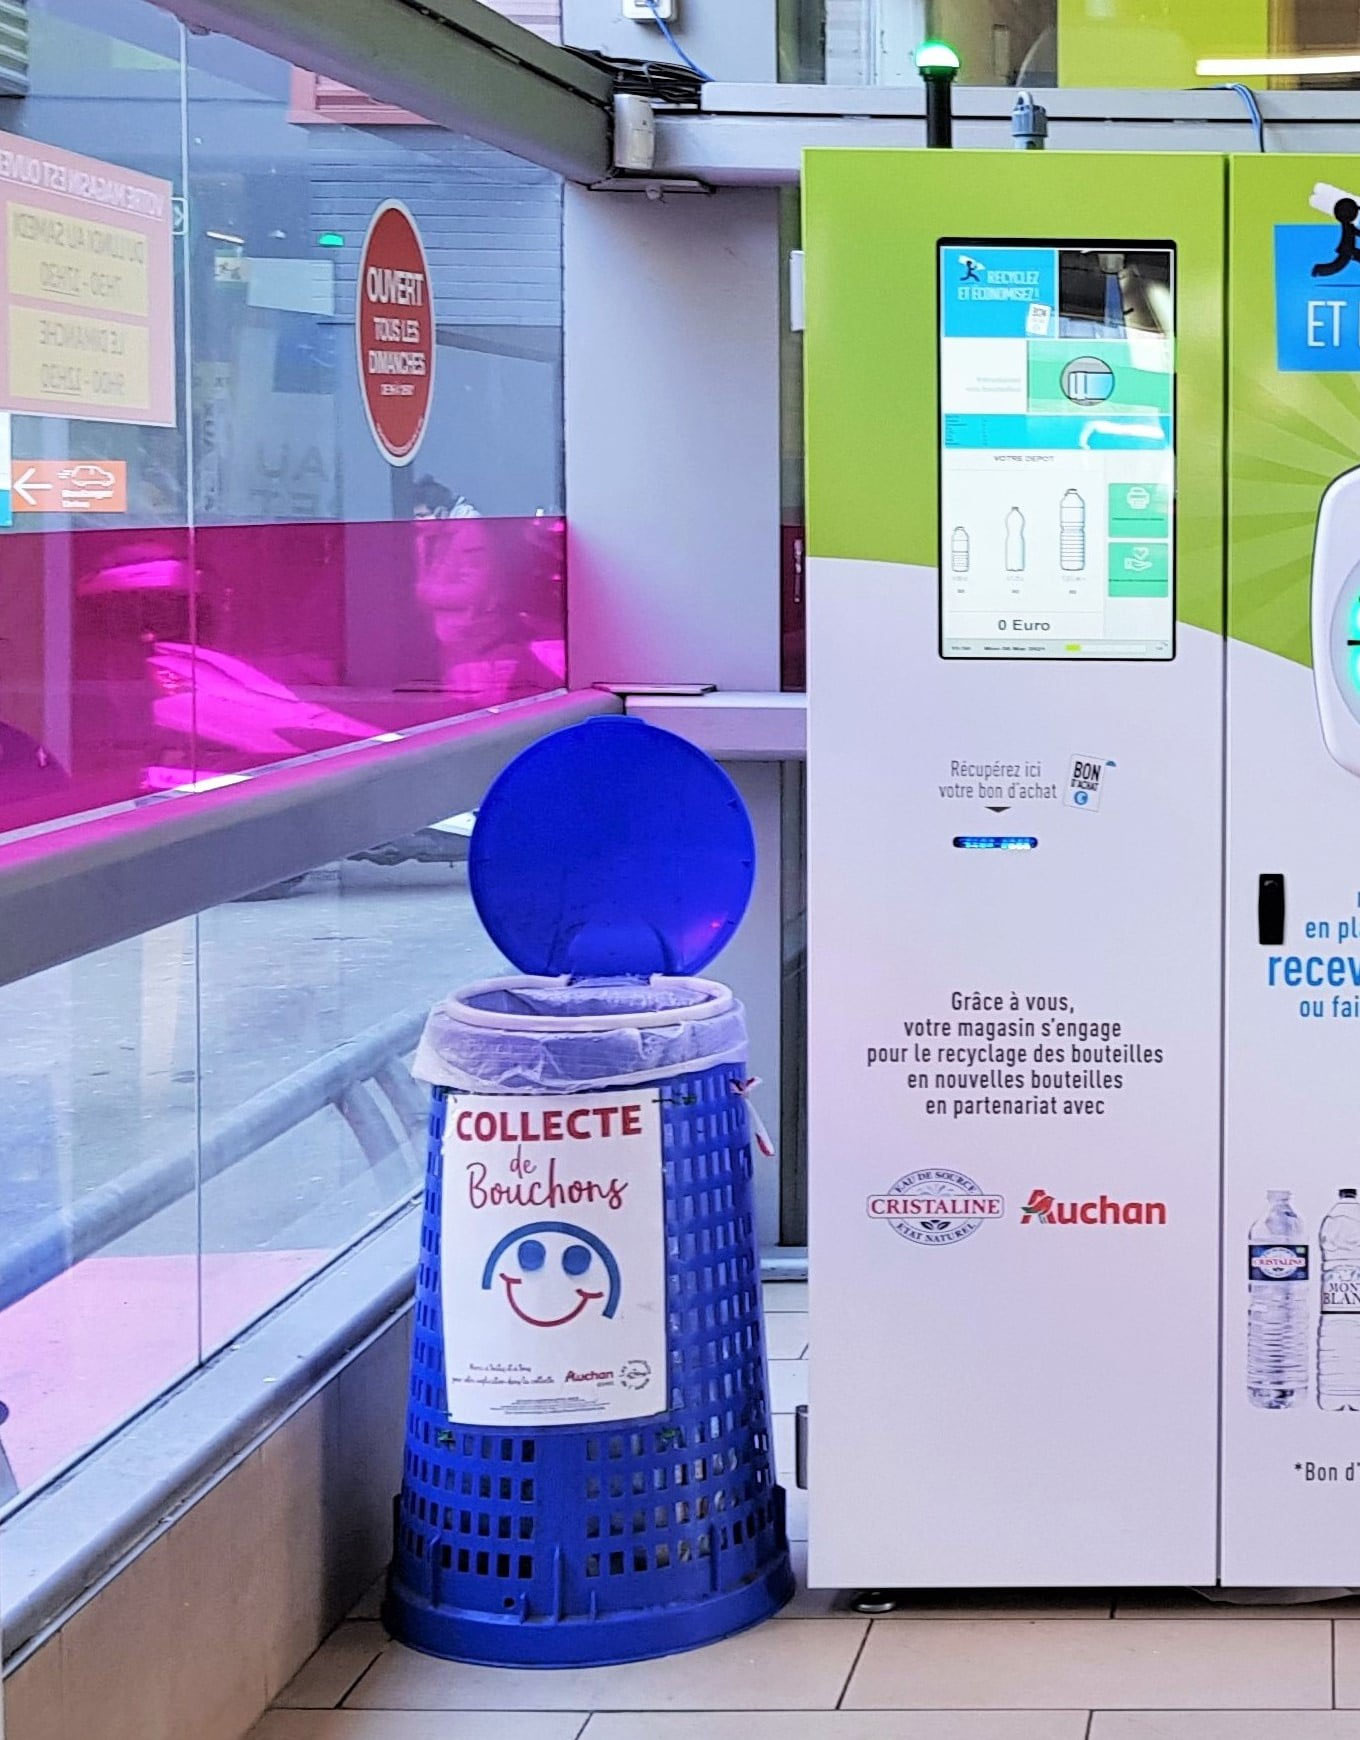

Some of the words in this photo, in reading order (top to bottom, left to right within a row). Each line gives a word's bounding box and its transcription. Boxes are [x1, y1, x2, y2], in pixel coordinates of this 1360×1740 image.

[366, 266, 424, 306] OUVERT
[987, 270, 1040, 285] RECYCLEZ
[373, 317, 400, 342] TOUS
[401, 320, 420, 343] LES
[1306, 299, 1347, 349] ET
[368, 350, 426, 376] DIMANCHES
[997, 619, 1007, 631] 0
[1013, 619, 1050, 631] Euro
[950, 760, 1020, 781] Récupérez
[1025, 761, 1042, 778] ici
[1073, 761, 1102, 782] BON
[939, 784, 974, 799] votre
[978, 782, 1003, 799] bon
[1007, 782, 1058, 799] d'achat
[1305, 921, 1330, 940] en
[951, 991, 1004, 1011] Grâce
[1009, 991, 1020, 1011] à
[1026, 996, 1075, 1014] vous,
[1299, 999, 1325, 1018] ou
[904, 1020, 952, 1037] votre
[957, 1018, 1035, 1041] magasin
[1041, 1018, 1122, 1041] s'engage
[867, 1046, 908, 1067] pour
[914, 1043, 932, 1063] le
[938, 1043, 1028, 1067] recyclage
[1033, 1043, 1065, 1063] des
[1071, 1043, 1164, 1063] bouteilles
[907, 1072, 929, 1088] en
[935, 1069, 1025, 1088] nouvelles
[1031, 1069, 1124, 1088] bouteilles
[925, 1099, 947, 1115] en
[953, 1096, 1058, 1119] partenariat
[1063, 1099, 1105, 1115] avec
[456, 1104, 642, 1142] COLLECTE
[509, 1144, 537, 1179] de
[466, 1157, 629, 1210] Bouchons
[894, 1177, 916, 1193] EAU
[917, 1171, 932, 1181] DE
[935, 1171, 977, 1192] SOURCE
[871, 1198, 1001, 1216] CRISTALINE
[1020, 1189, 1167, 1225] Auchan
[924, 1223, 976, 1243] NATUREL
[564, 1370, 614, 1383] Auchan
